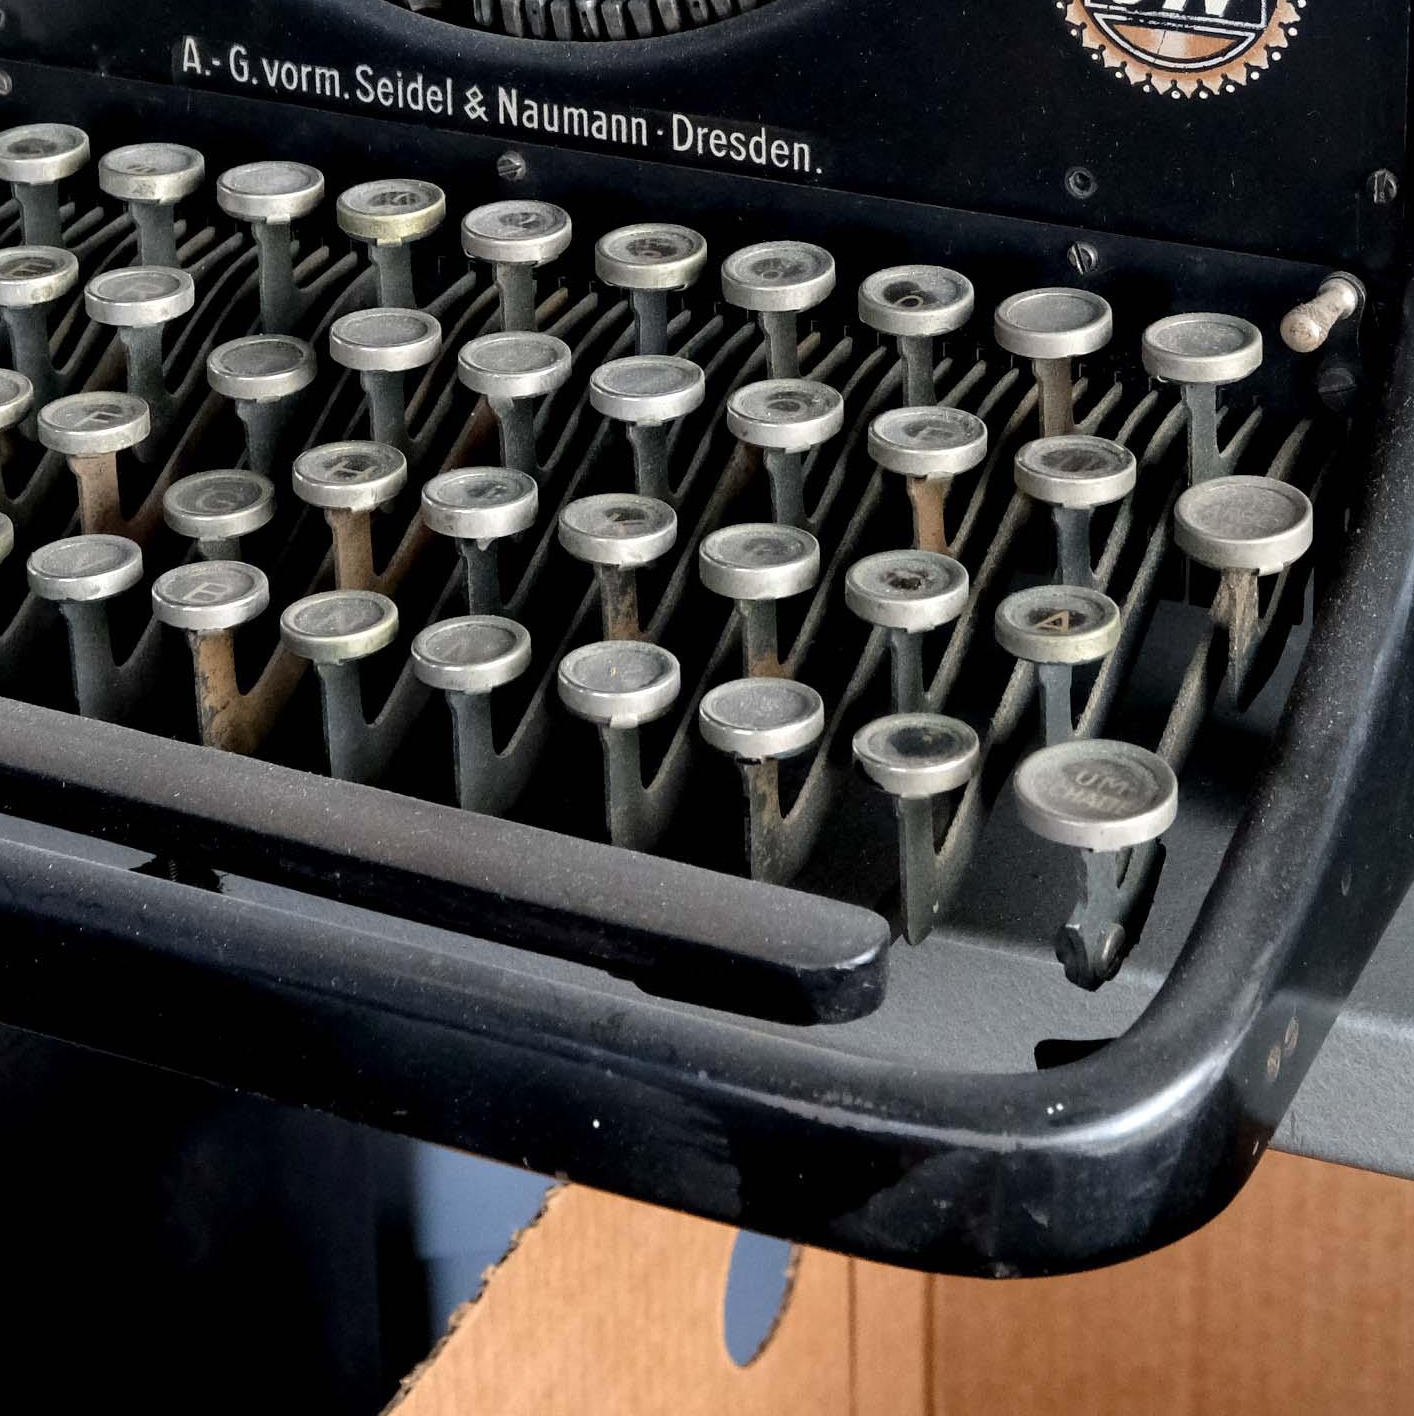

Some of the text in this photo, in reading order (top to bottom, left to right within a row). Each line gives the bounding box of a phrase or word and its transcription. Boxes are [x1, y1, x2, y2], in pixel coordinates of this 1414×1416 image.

[260, 50, 350, 101] vorm.
[355, 64, 453, 117] Seidel
[464, 85, 490, 122] &
[496, 87, 649, 147] Naumann
[670, 114, 824, 176] Dresden.
